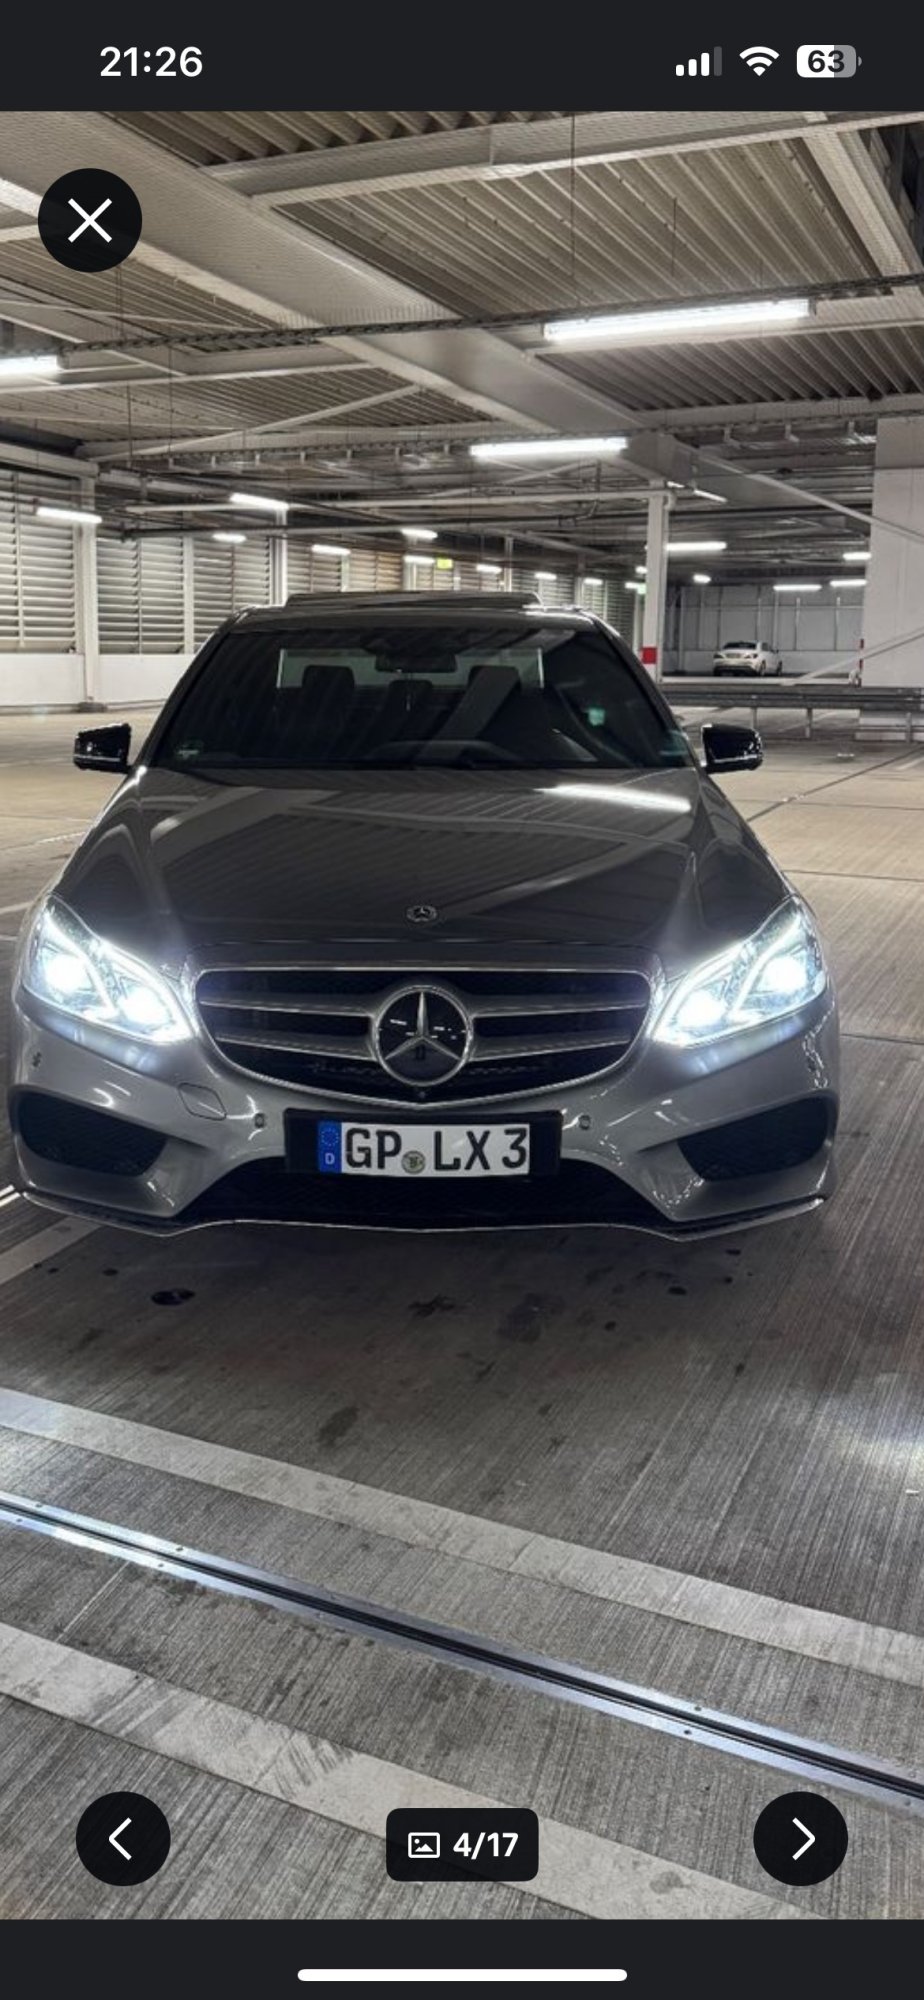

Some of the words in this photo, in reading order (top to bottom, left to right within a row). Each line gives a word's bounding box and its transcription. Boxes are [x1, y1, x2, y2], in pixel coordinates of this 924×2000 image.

[325, 1153, 335, 1165] D
[345, 1127, 402, 1169] GP
[434, 1130, 491, 1171] LX
[502, 1127, 527, 1169] 3
